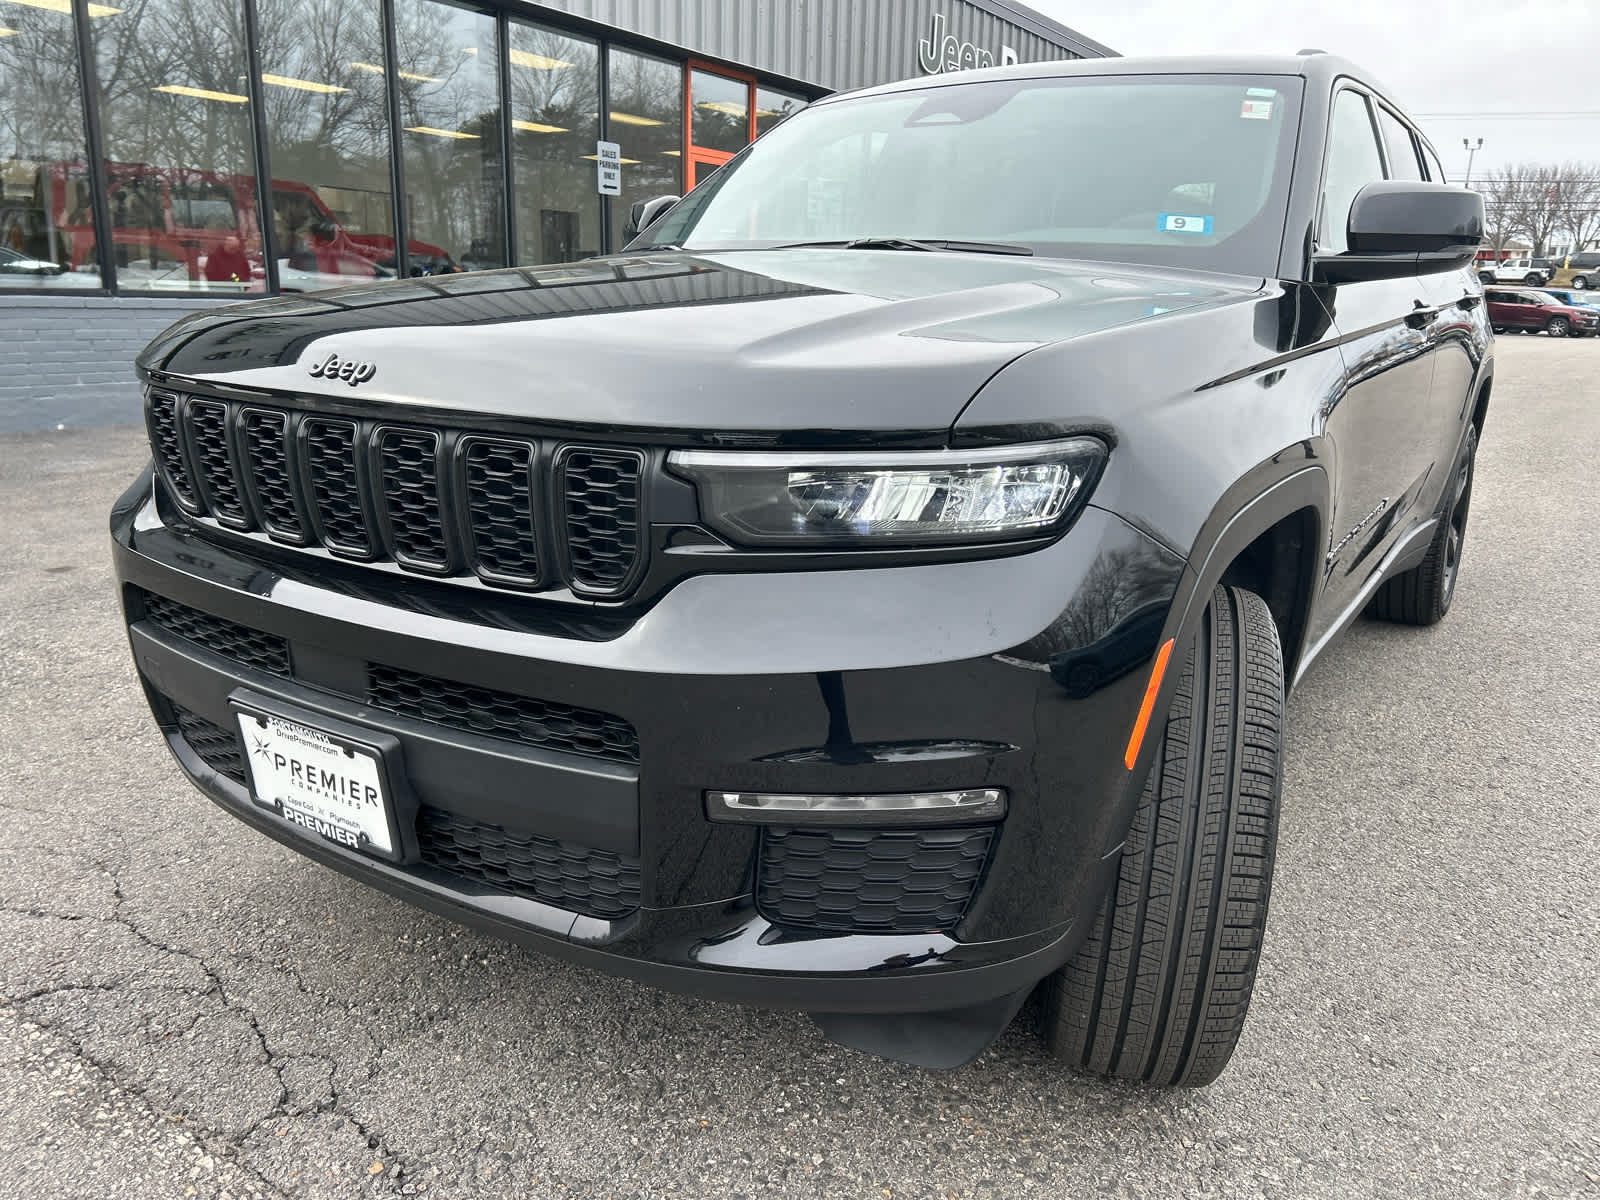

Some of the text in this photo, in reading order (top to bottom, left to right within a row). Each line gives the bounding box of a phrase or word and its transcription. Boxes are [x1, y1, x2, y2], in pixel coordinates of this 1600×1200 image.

[919, 13, 994, 74] Jeep
[600, 160, 619, 170] PARKING
[602, 150, 616, 159] SALES
[604, 172, 615, 180] ONLY
[1174, 217, 1186, 228] 9
[308, 353, 376, 387] Jeep
[274, 753, 378, 807] PREMIER
[291, 778, 361, 810] COMPANIES
[283, 807, 359, 848] PREMIER
[329, 811, 361, 829] Plymouth
